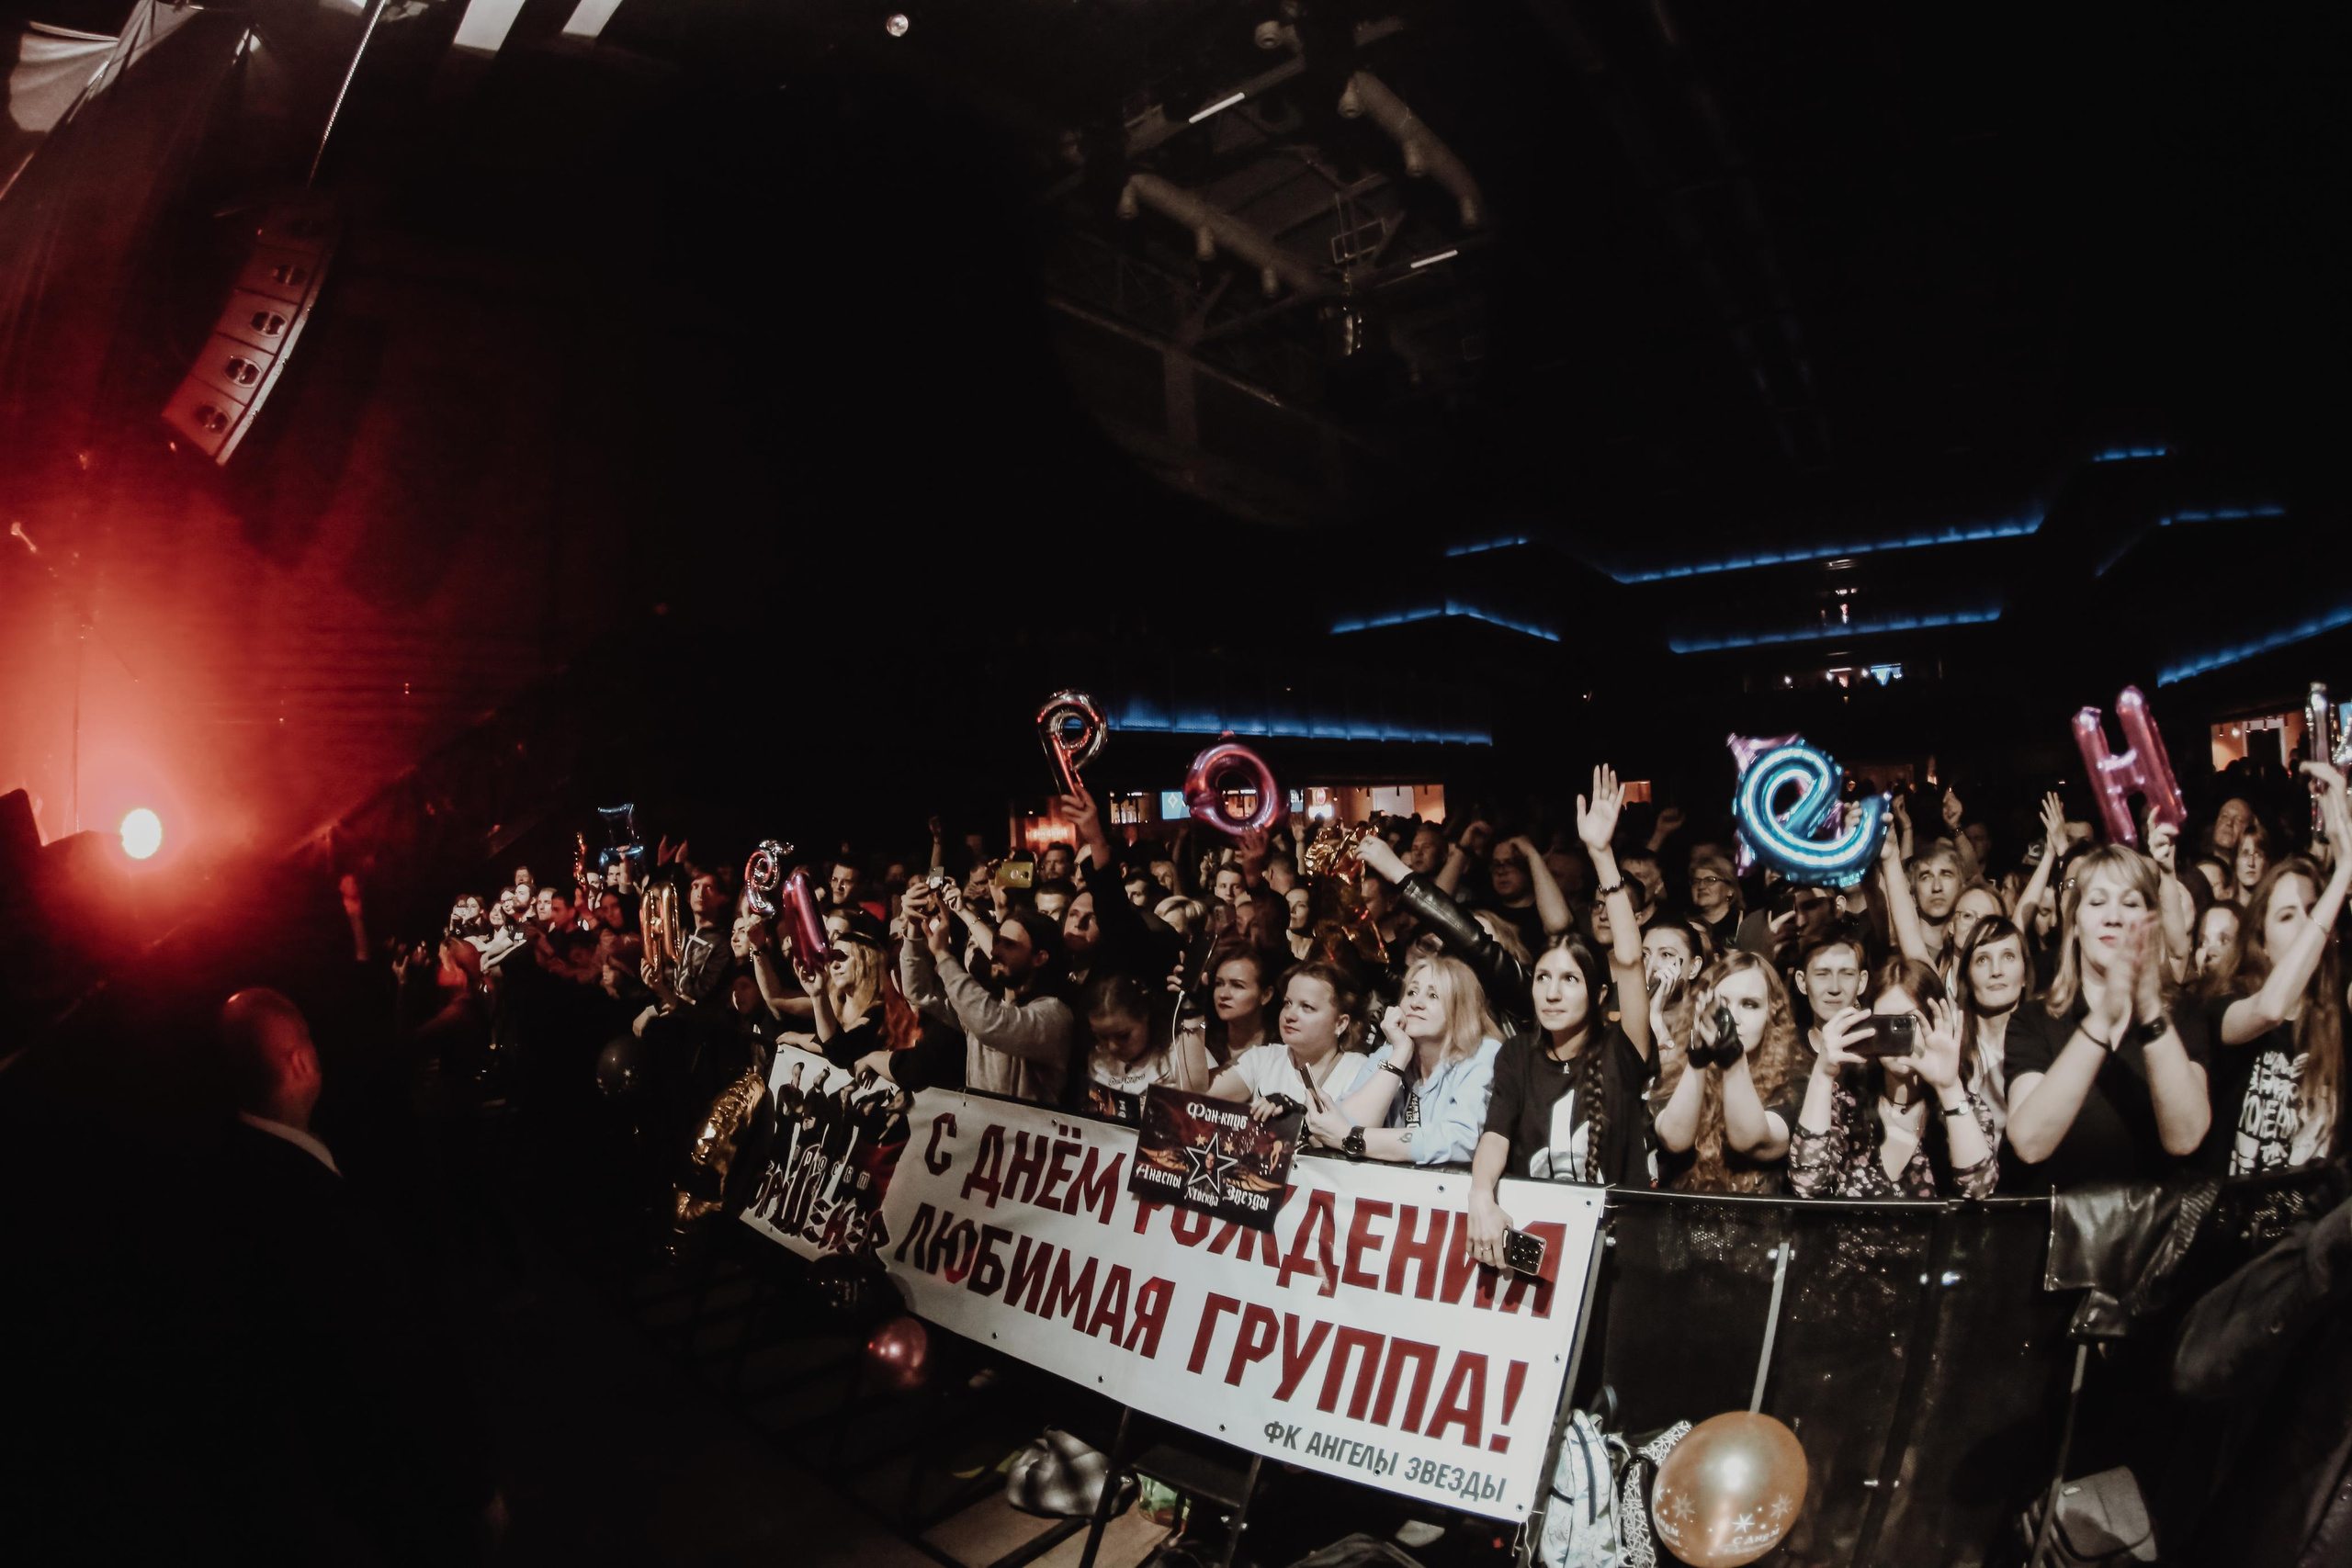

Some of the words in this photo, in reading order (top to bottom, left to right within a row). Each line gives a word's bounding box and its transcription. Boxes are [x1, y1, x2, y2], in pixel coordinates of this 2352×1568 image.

[924, 1112, 957, 1177] С
[960, 1123, 1127, 1226] ДНЁМ
[894, 1202, 1176, 1359] ЛЮБИМАЯ
[1186, 1292, 1530, 1455] ГРУППА!
[1263, 1420, 1300, 1450] ФК
[1306, 1431, 1399, 1476] АНГЕЛЫ
[1405, 1456, 1508, 1503] ЗВЕЗДЫ
